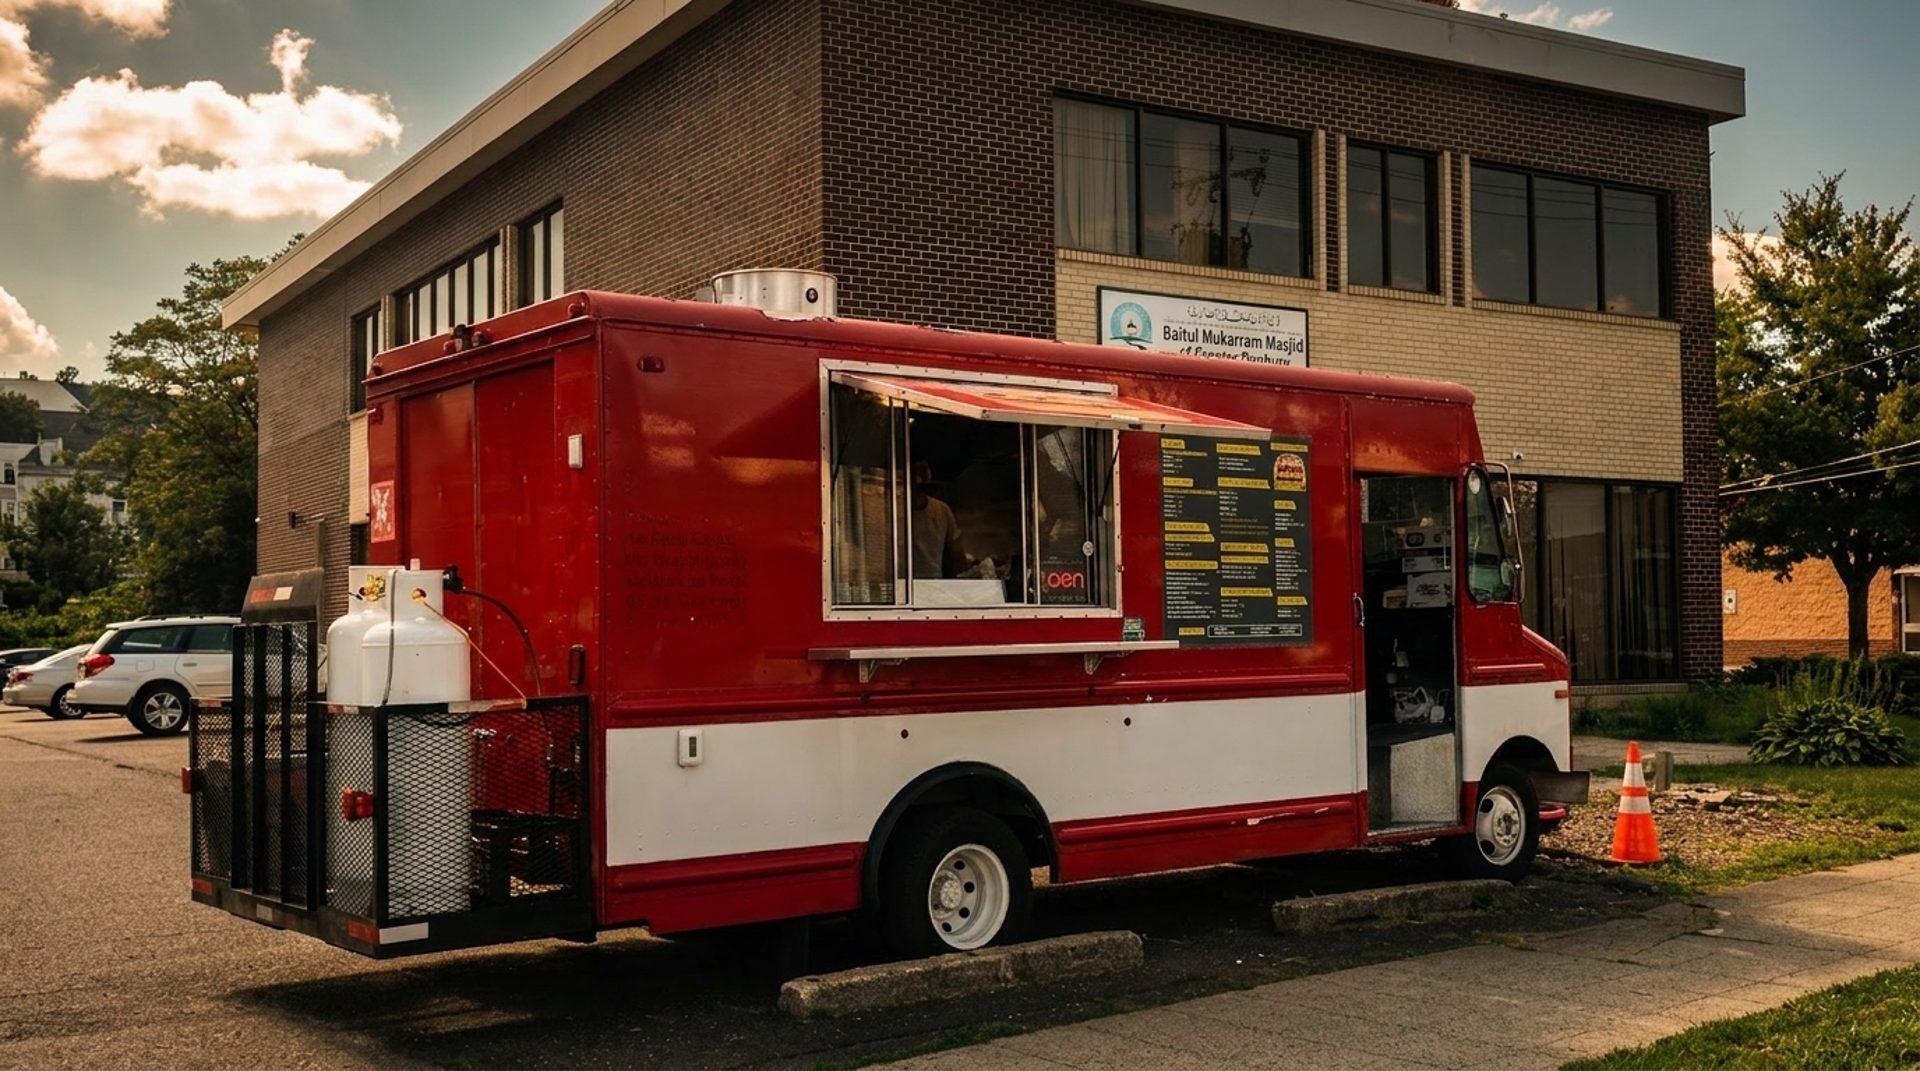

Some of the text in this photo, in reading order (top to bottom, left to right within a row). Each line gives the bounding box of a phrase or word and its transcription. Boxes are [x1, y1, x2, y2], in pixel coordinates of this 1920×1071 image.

[1163, 325, 1304, 356] Baitul Mukarram Masjid
